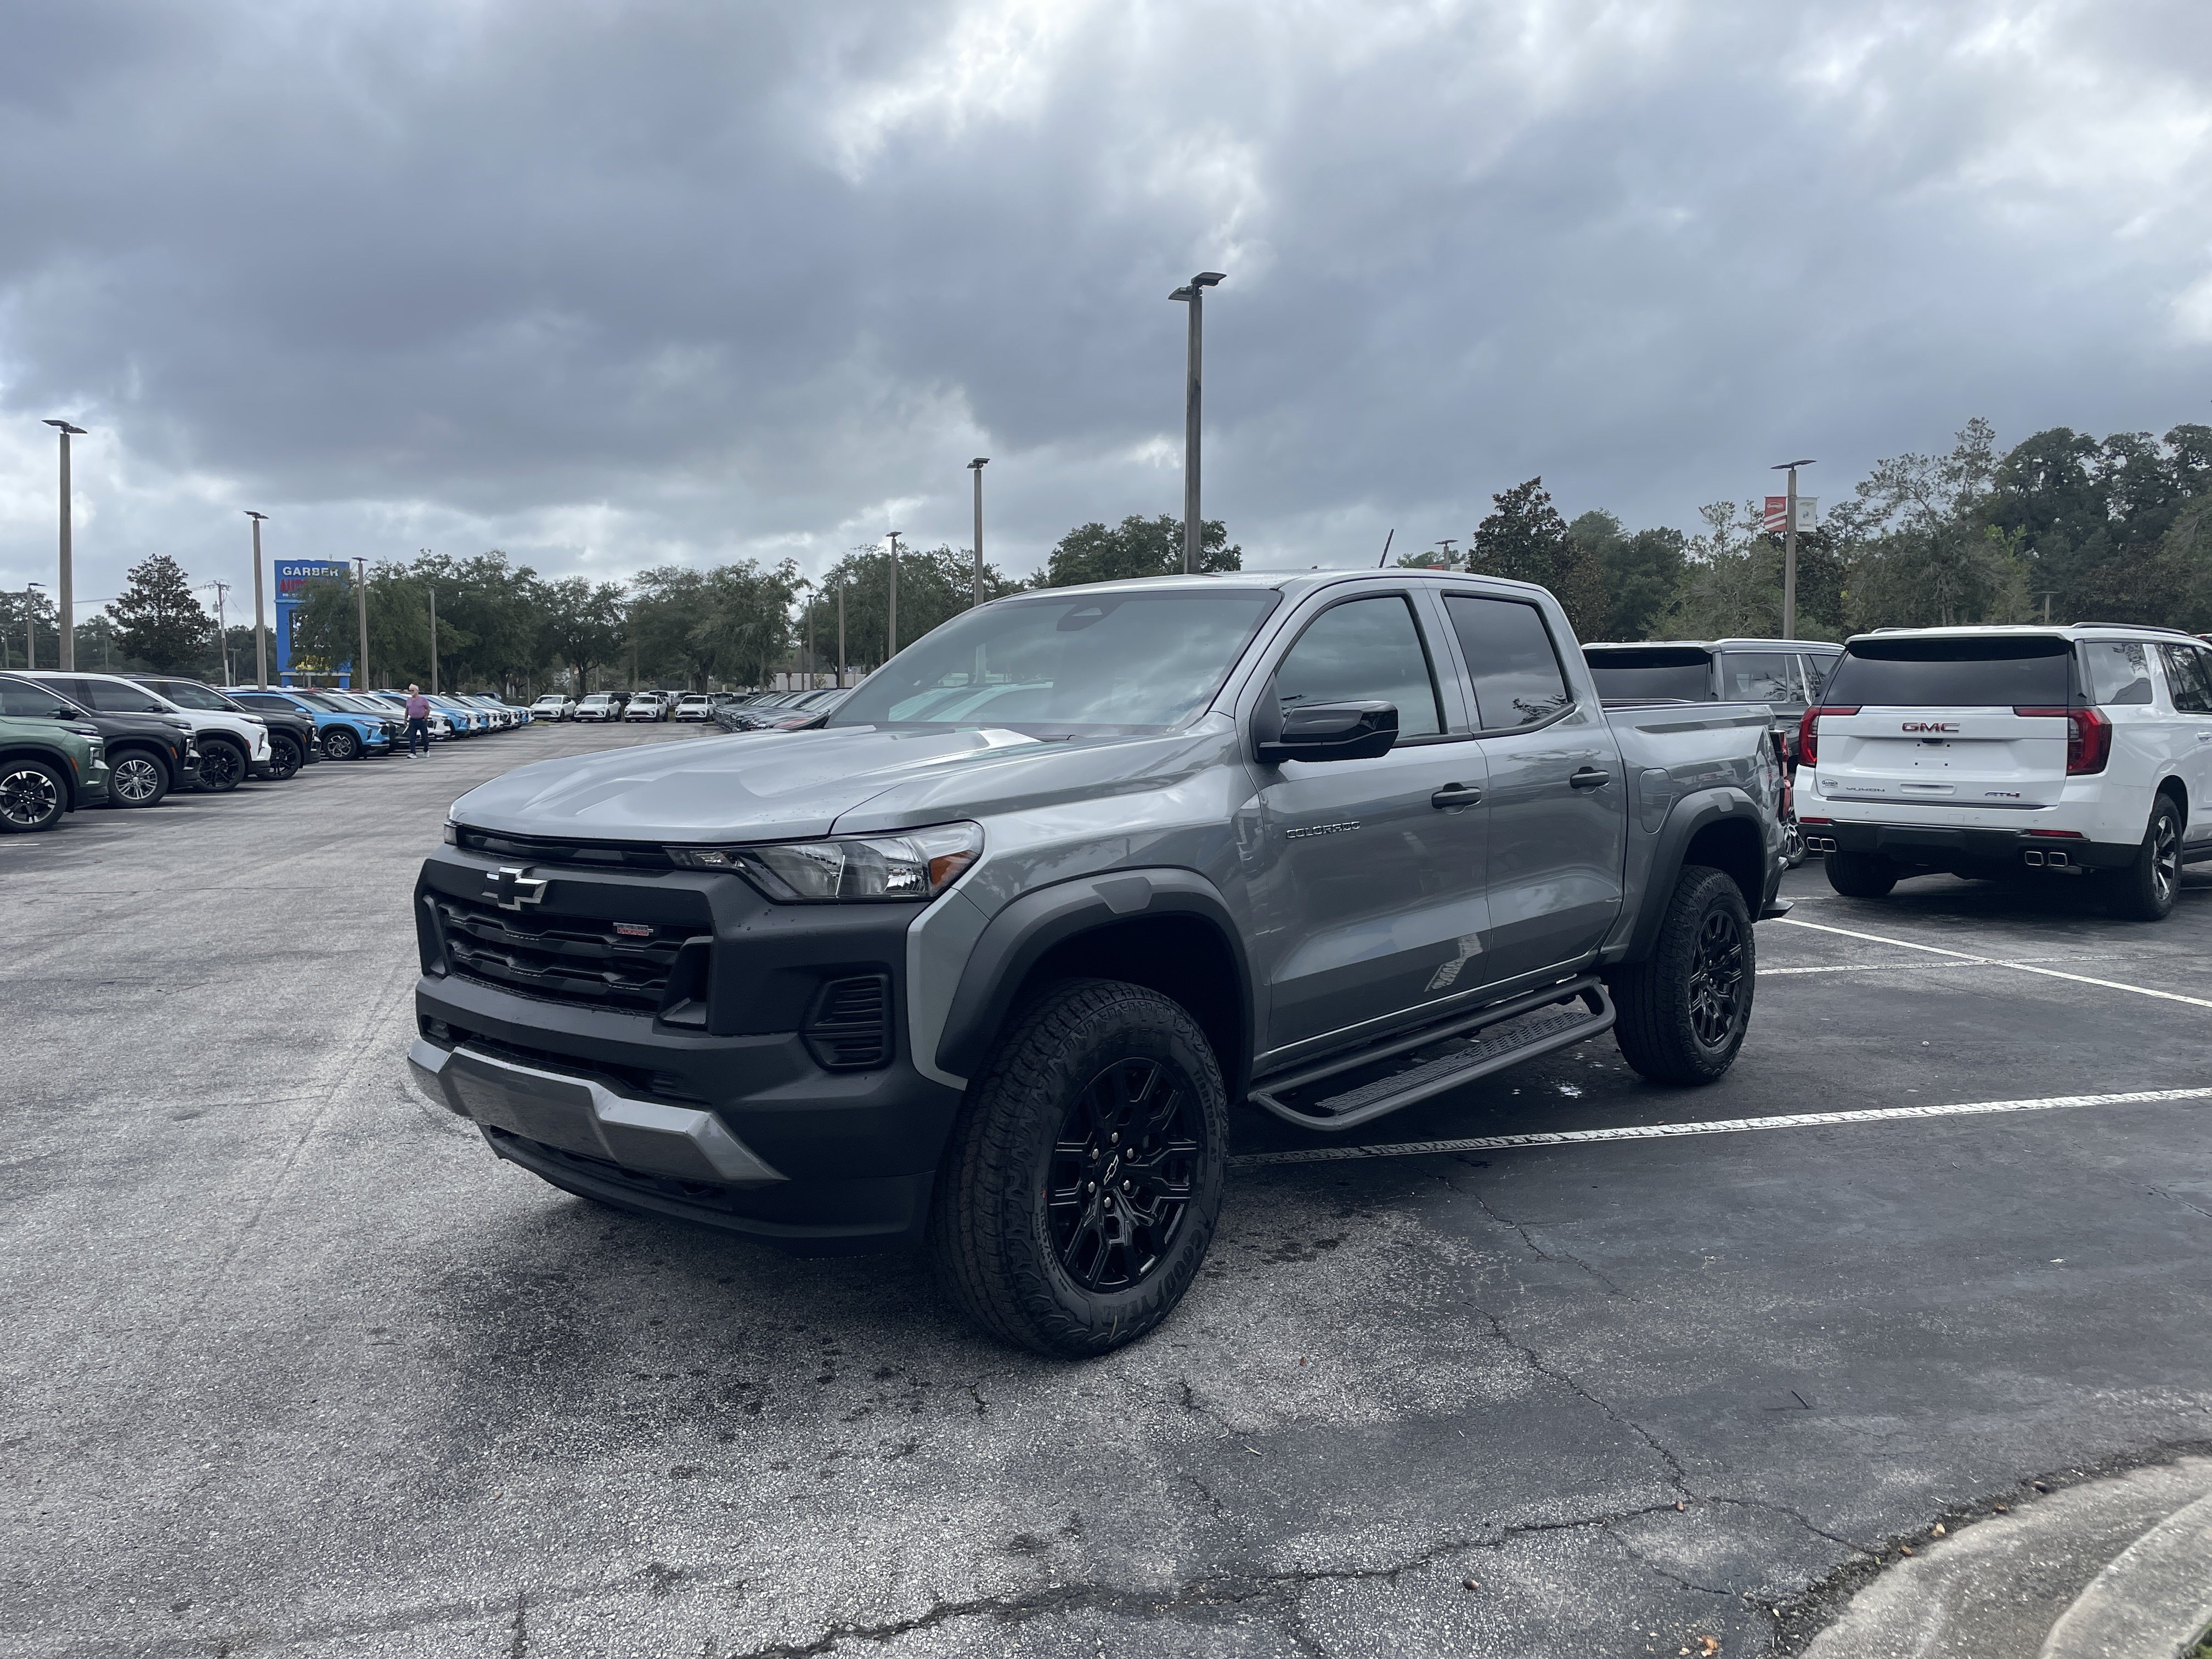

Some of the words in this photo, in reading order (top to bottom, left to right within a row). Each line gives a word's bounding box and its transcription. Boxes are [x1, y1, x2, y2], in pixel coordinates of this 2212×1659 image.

[283, 567, 338, 577] GARBER
[1902, 722, 1960, 733] GMC
[1286, 821, 1361, 839] COLORADO
[1101, 1229, 1203, 1326] GOODYEAR
